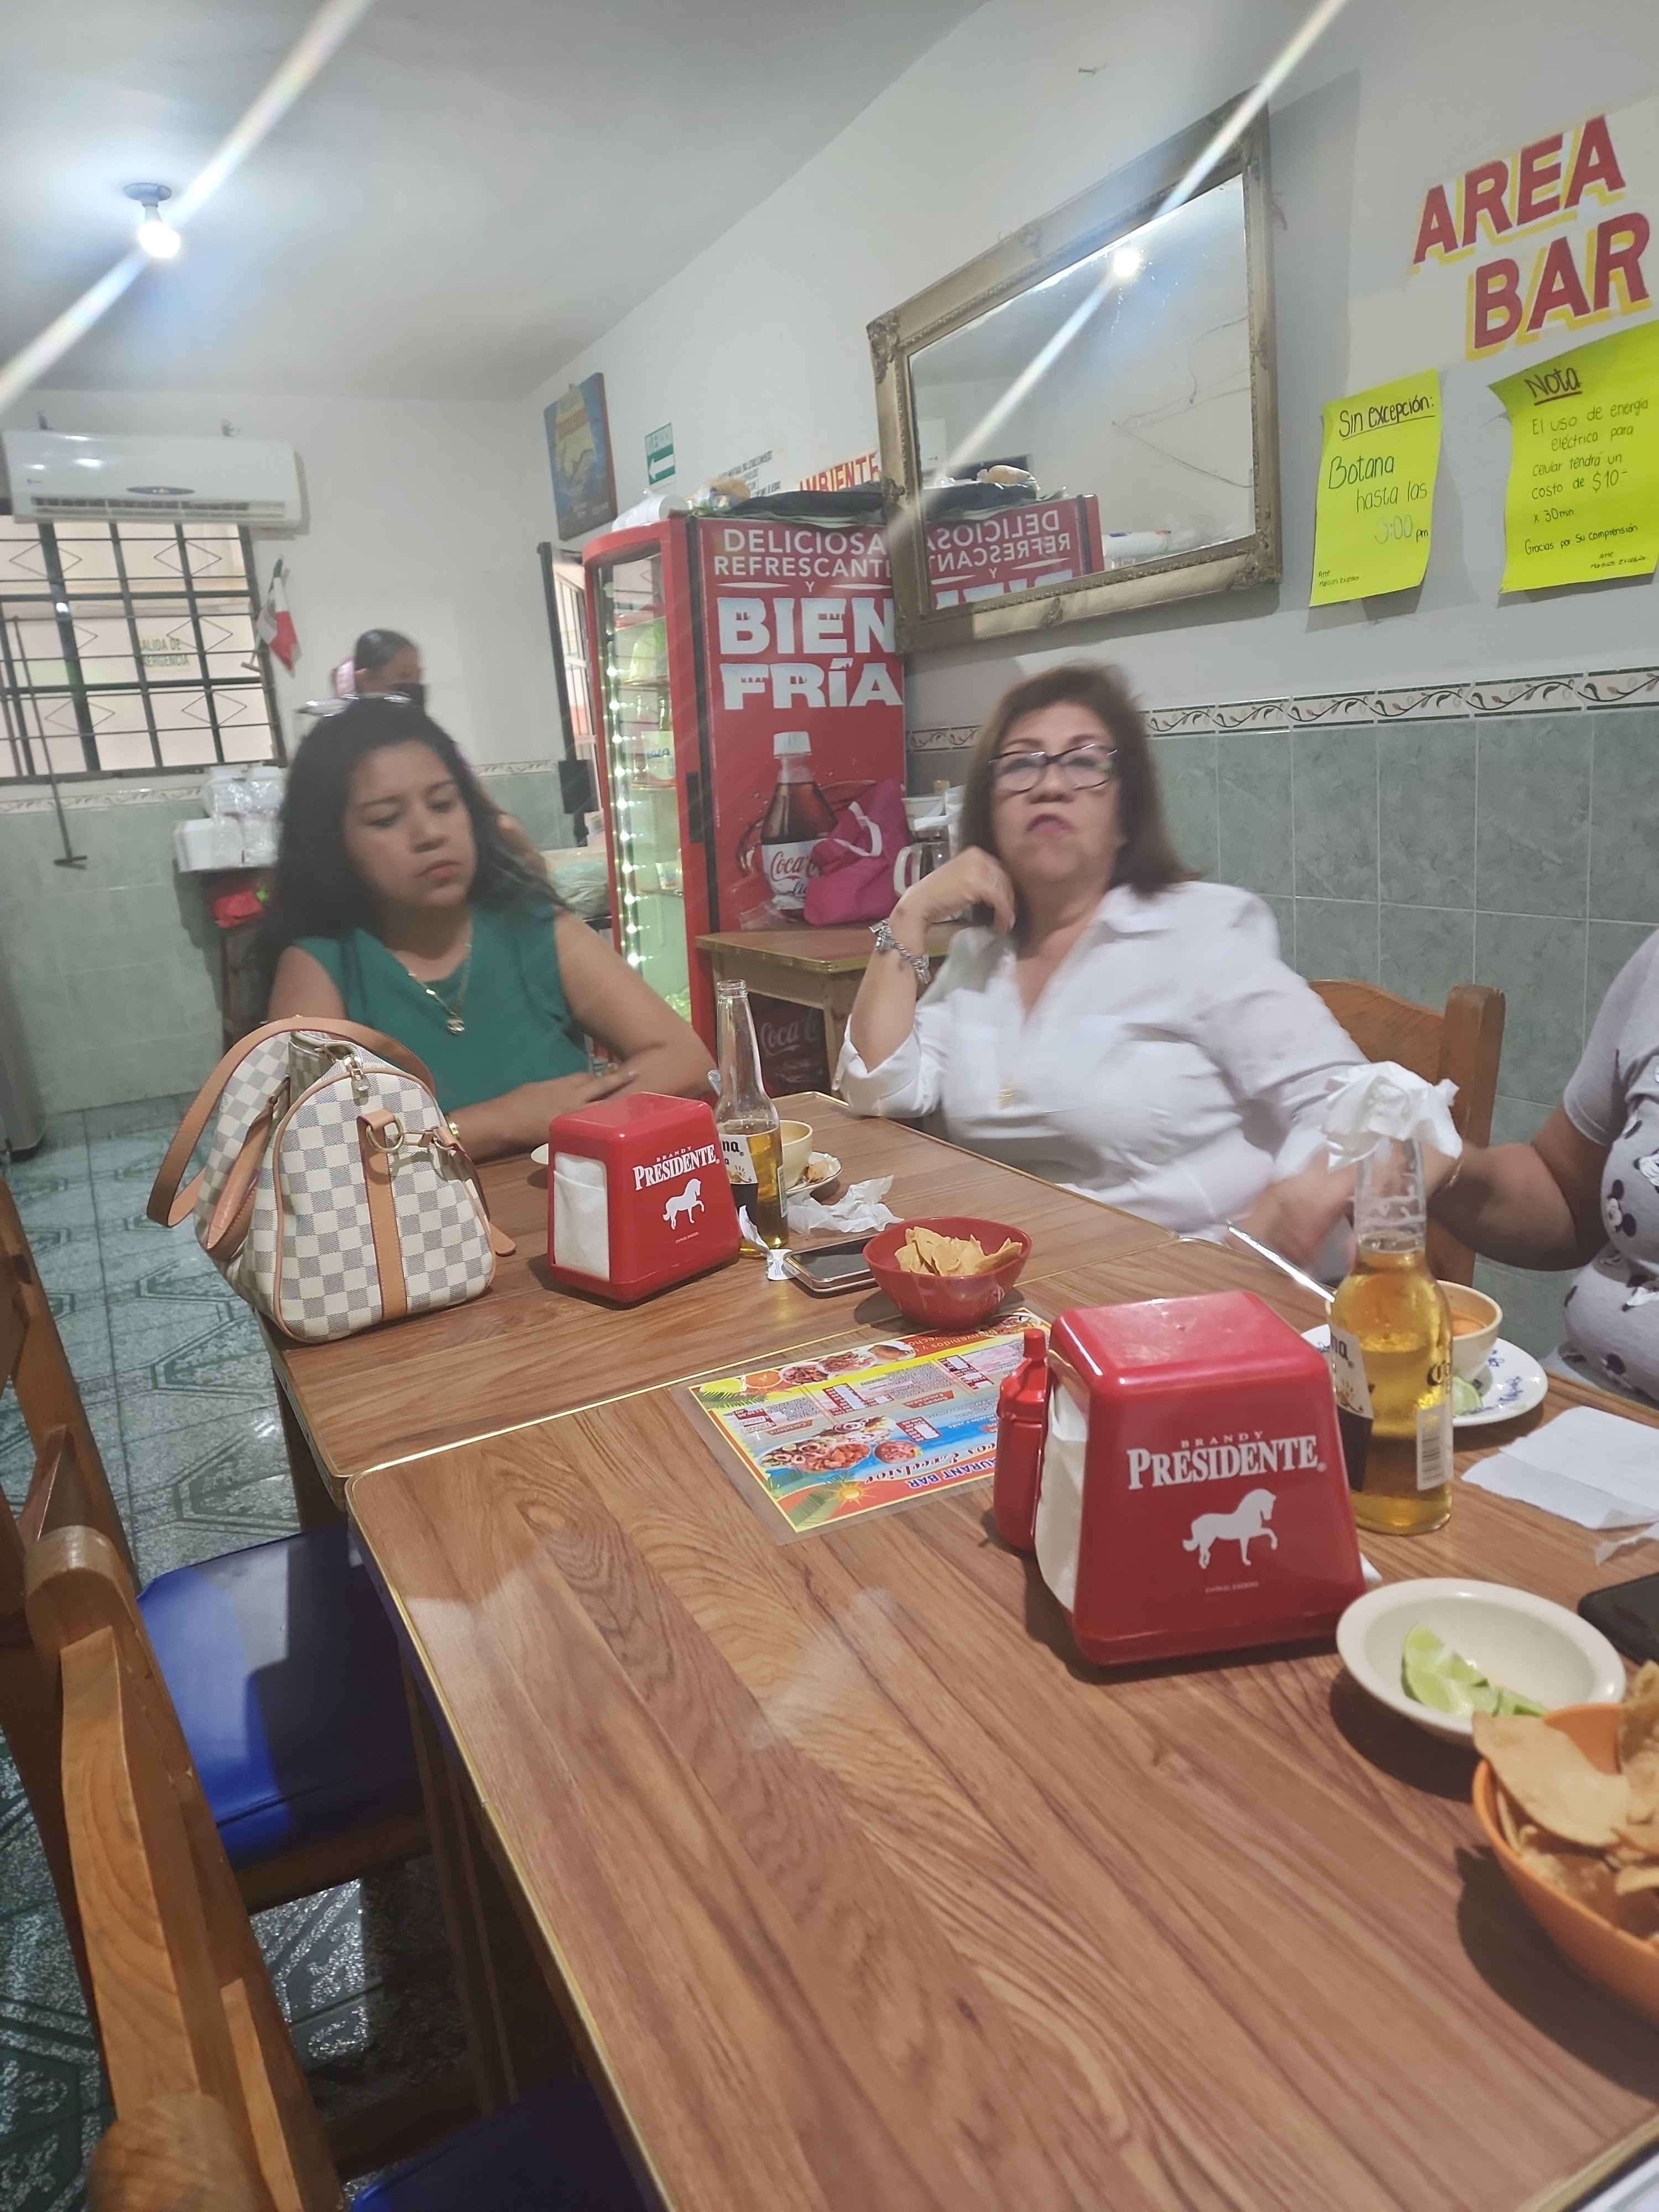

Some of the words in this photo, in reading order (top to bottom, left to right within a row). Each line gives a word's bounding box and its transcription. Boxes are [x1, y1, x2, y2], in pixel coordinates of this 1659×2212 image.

[1412, 113, 1627, 267] AREA
[1471, 212, 1651, 352] BAR
[1524, 367, 1582, 399] Nota
[1339, 410, 1364, 438] Sin
[1532, 419, 1544, 436] El
[1551, 417, 1578, 432] uso
[1587, 406, 1603, 422] de
[1610, 397, 1649, 418] energía
[1551, 431, 1599, 452] eléctrica
[1610, 425, 1635, 442] para
[1328, 455, 1395, 490] Botana
[1532, 461, 1563, 478] celular
[1569, 451, 1602, 470] tendrá
[1607, 453, 1623, 466] un
[1356, 486, 1399, 513] hasta
[1407, 480, 1428, 503] las
[1531, 483, 1564, 500] costo
[1572, 477, 1585, 490] de
[723, 528, 888, 555] DELICIOSA
[1416, 528, 1429, 544] pm
[1525, 539, 1554, 555] Gracias
[1560, 538, 1572, 549] por
[1588, 523, 1639, 541] comprensión
[805, 581, 816, 593] Y
[717, 597, 896, 655] BIEN
[169, 637, 181, 651] DE
[719, 657, 904, 710] FRÍA
[656, 1145, 692, 1163] BRANDY
[1181, 1430, 1264, 1449] BRANDY
[906, 1474, 942, 1489] BAR
